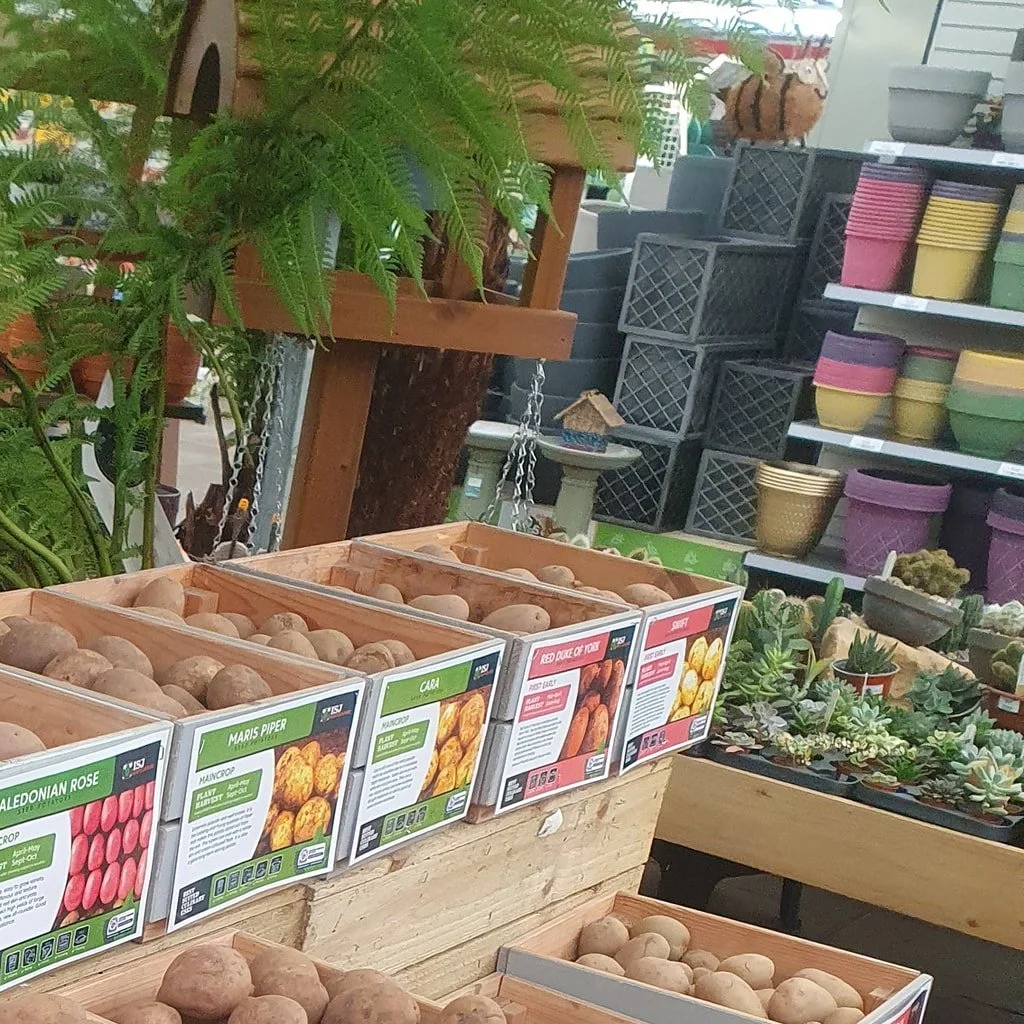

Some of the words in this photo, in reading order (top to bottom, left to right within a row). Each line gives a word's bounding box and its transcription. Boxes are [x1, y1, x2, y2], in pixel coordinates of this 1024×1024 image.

[540, 652, 555, 665] RED
[555, 648, 574, 662] DUKE
[574, 646, 584, 656] OF
[584, 641, 601, 653] YORK
[419, 678, 440, 693] CARA
[228, 725, 258, 746] MARIS
[260, 718, 287, 737] PIPER
[133, 758, 146, 770] ISJ
[70, 771, 99, 793] ROSE
[199, 767, 235, 784] MAINCROP
